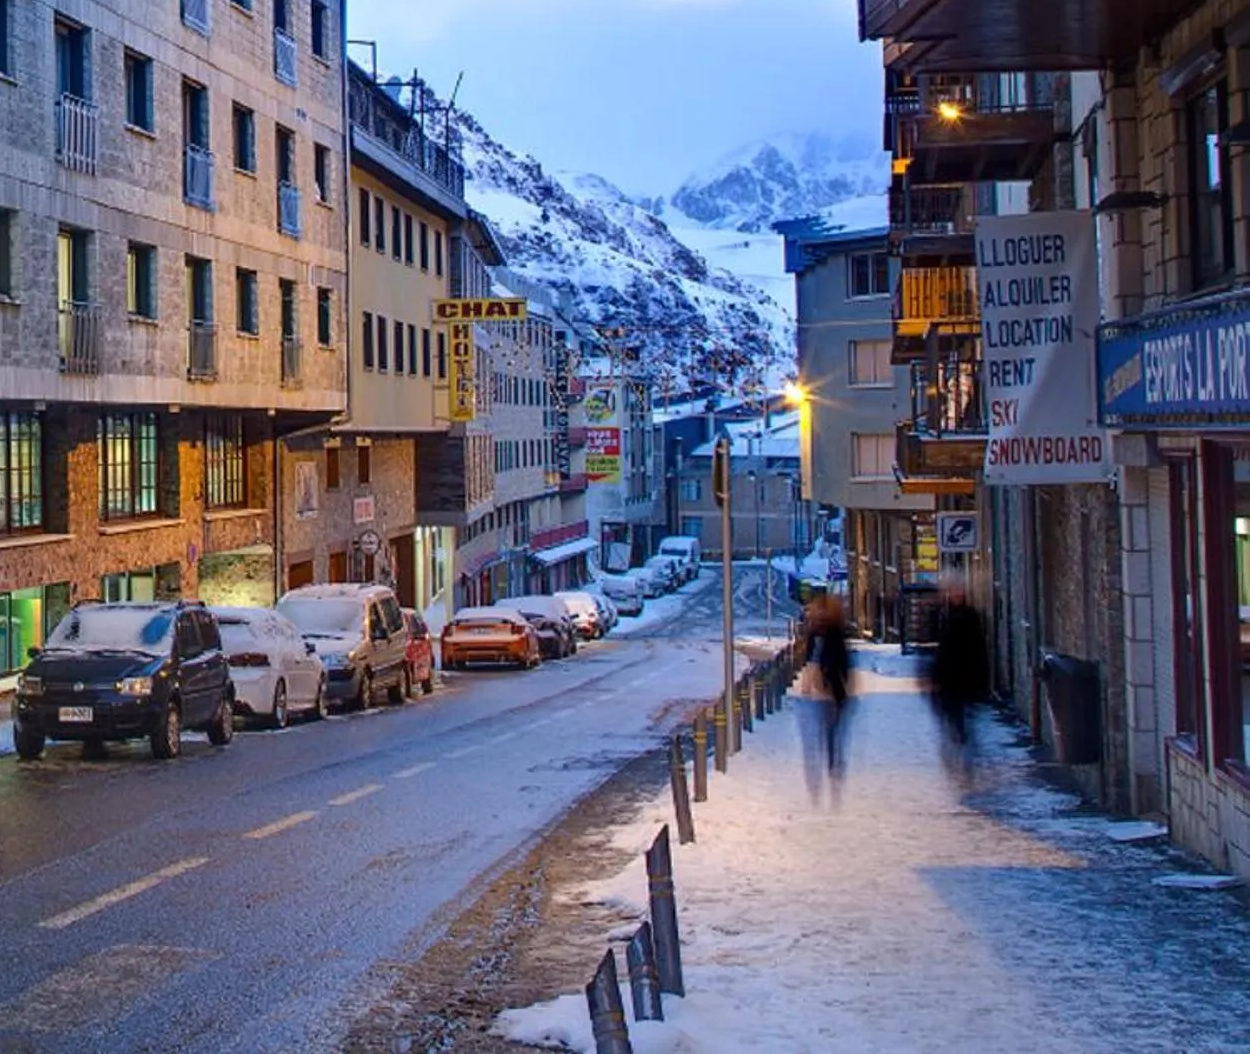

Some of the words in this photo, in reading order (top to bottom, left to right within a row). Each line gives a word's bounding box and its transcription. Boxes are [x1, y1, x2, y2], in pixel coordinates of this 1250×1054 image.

[980, 234, 1065, 267] LLOGUER
[984, 276, 1071, 307] ALQUILER
[437, 301, 525, 317] CHAT
[986, 316, 1073, 348] LOCATION
[990, 358, 1035, 387] RENT
[1195, 329, 1215, 401] LA
[991, 400, 1019, 427] SKI
[988, 436, 1102, 466] SNOWBOARD
